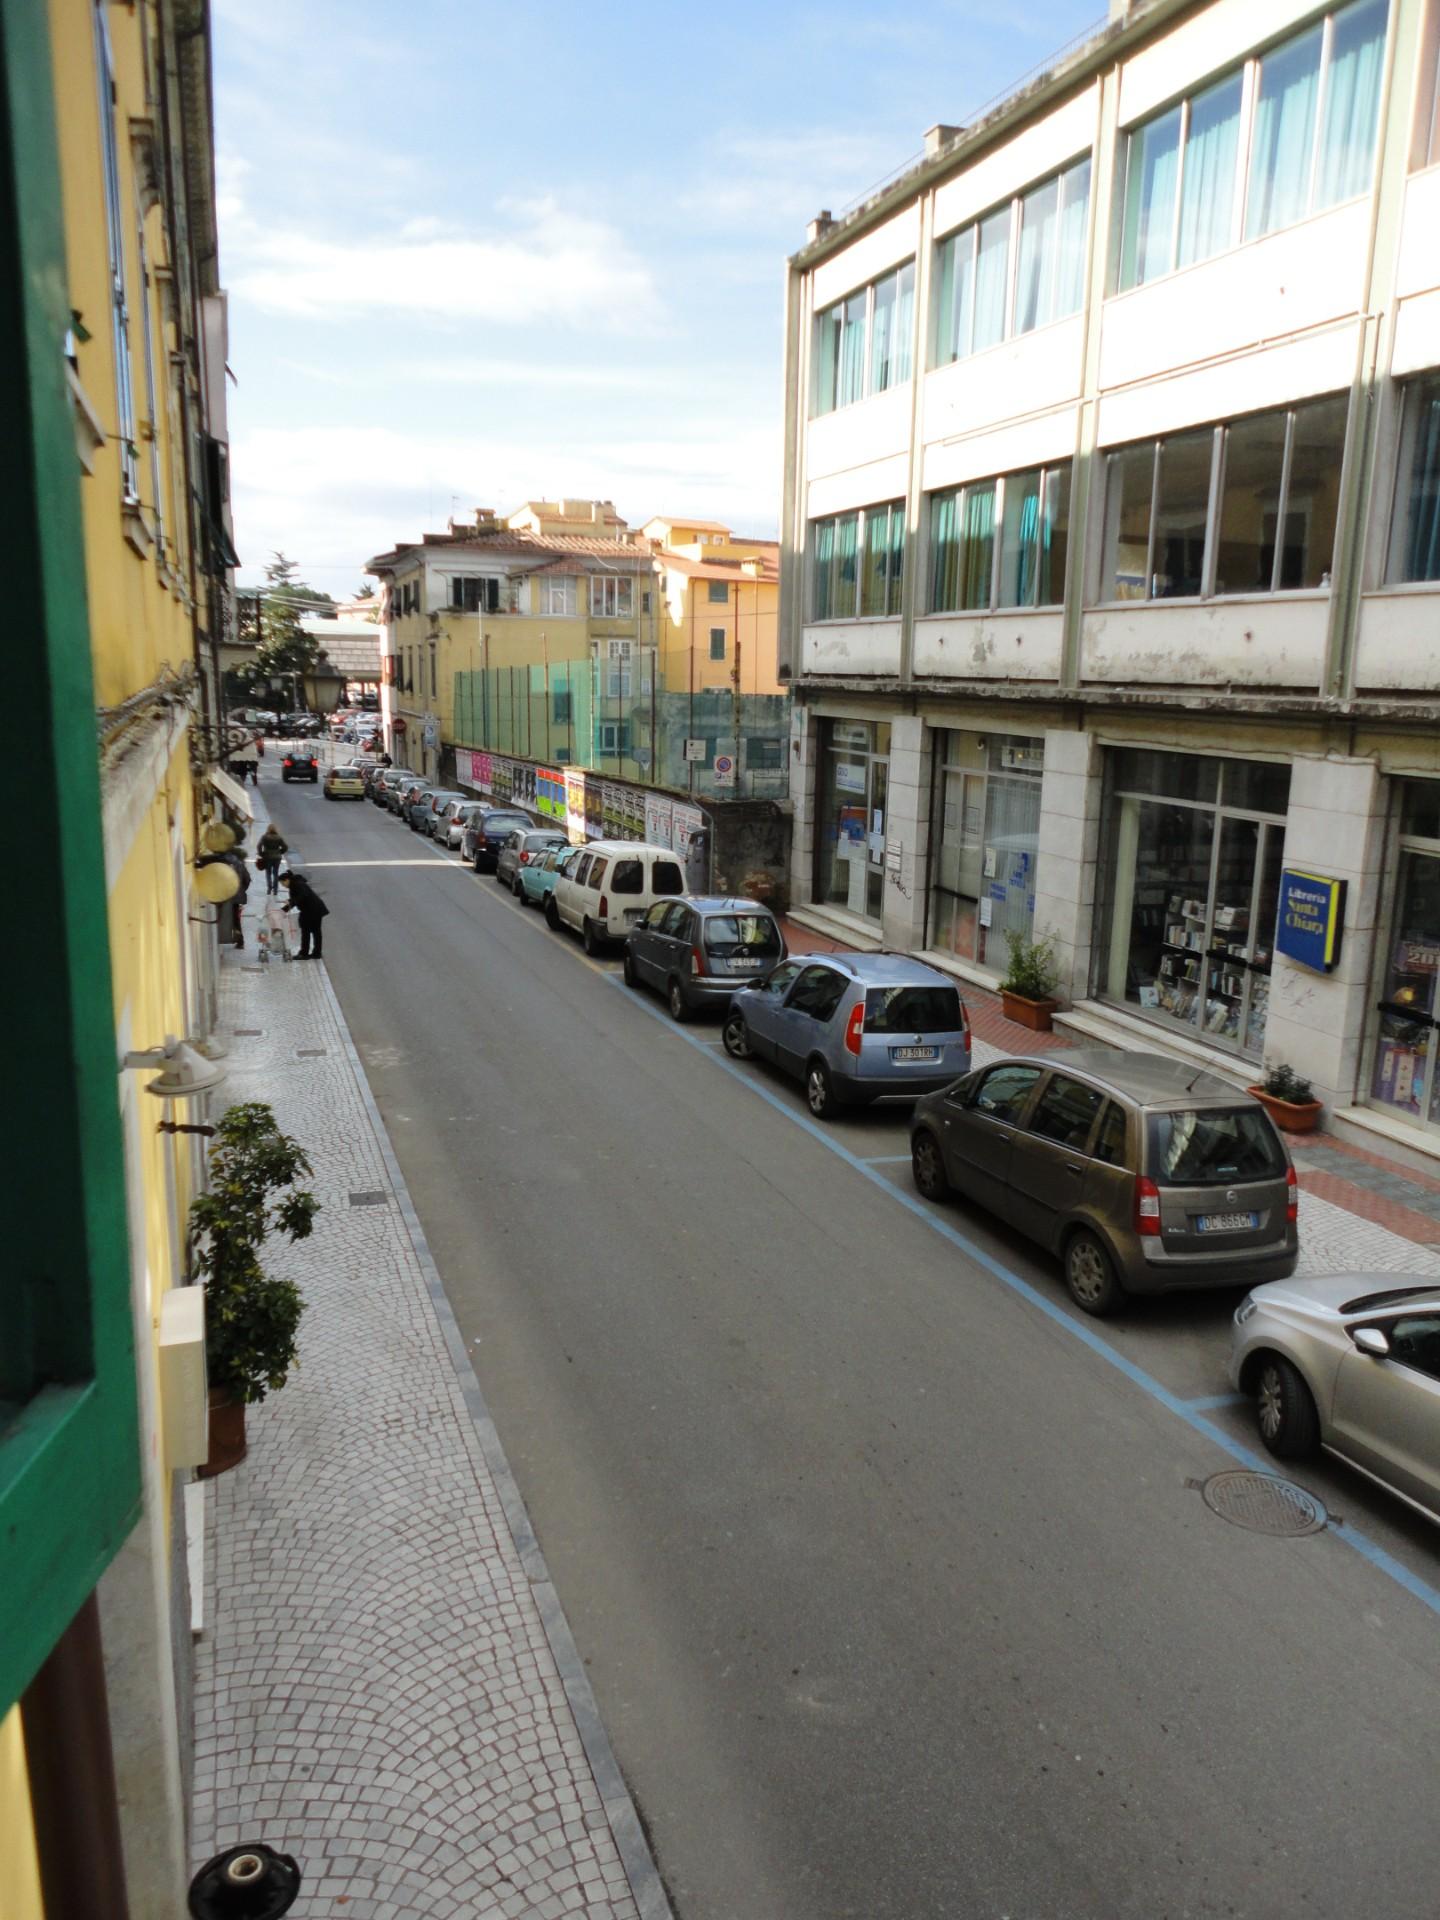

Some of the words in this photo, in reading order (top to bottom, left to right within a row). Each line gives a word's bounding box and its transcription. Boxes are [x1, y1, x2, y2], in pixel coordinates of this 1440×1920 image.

[1289, 887, 1326, 904] Libreria
[1287, 899, 1318, 916] Santa
[1285, 913, 1324, 935] Chiara
